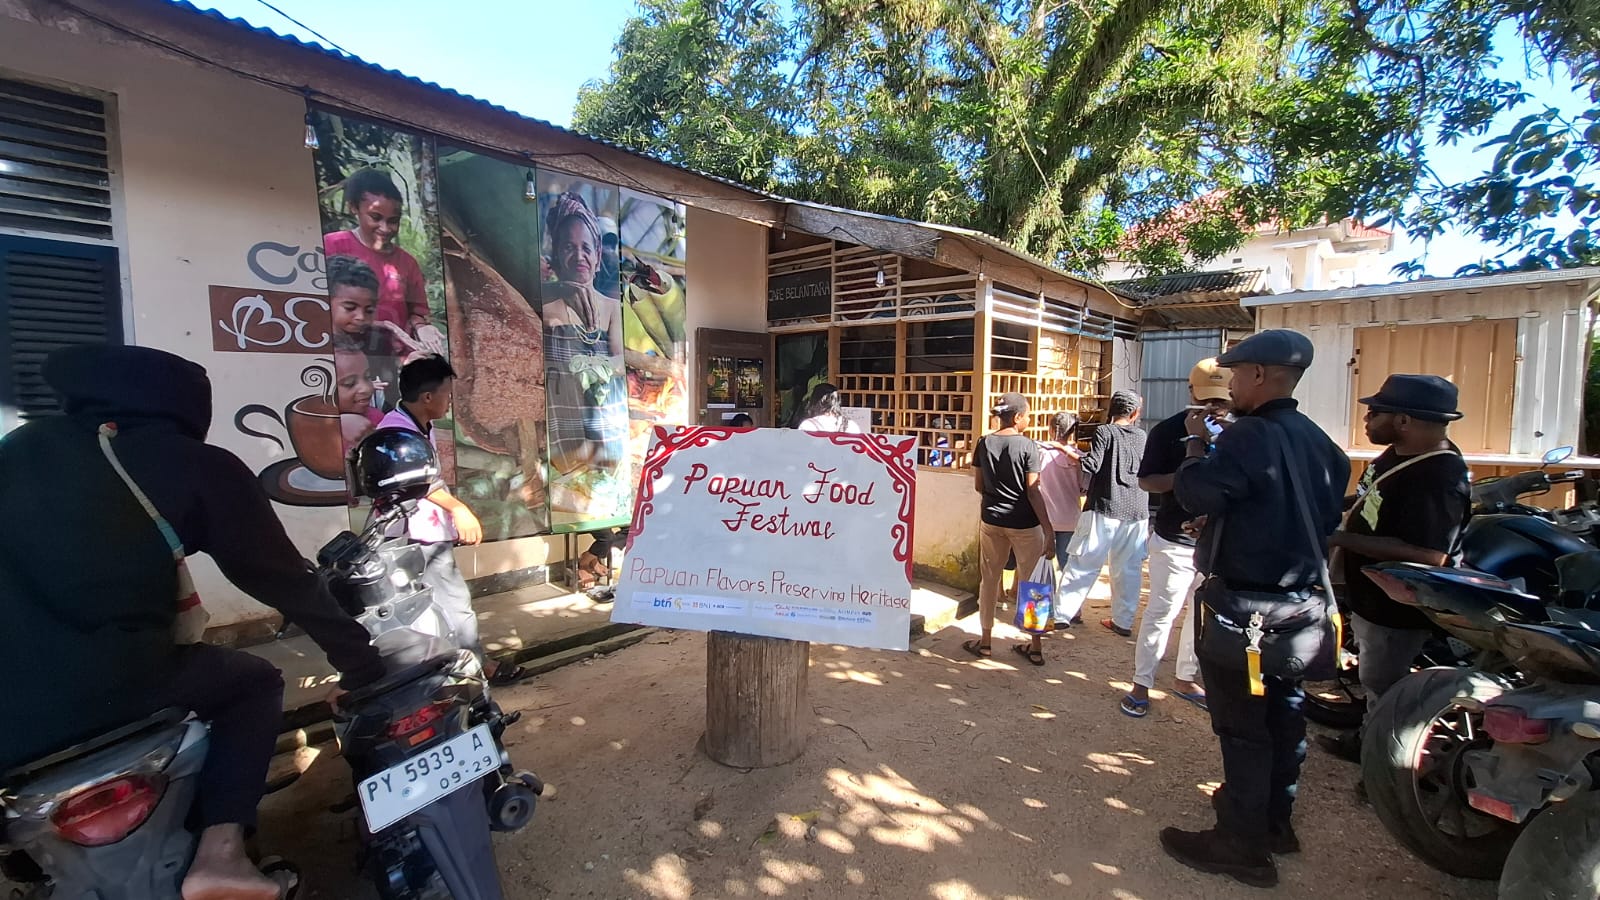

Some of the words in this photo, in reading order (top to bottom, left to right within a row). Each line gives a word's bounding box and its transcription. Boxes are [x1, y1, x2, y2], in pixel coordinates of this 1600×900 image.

[247, 241, 328, 289] Ca
[785, 280, 830, 300] BELANTARA
[684, 463, 791, 502] Papuan
[803, 462, 875, 506] Food
[630, 557, 699, 586] Papuan
[771, 570, 845, 603] Preserving
[850, 583, 910, 609] Heritage
[366, 773, 392, 802] PY
[404, 745, 455, 782] 5939
[472, 732, 483, 751] A
